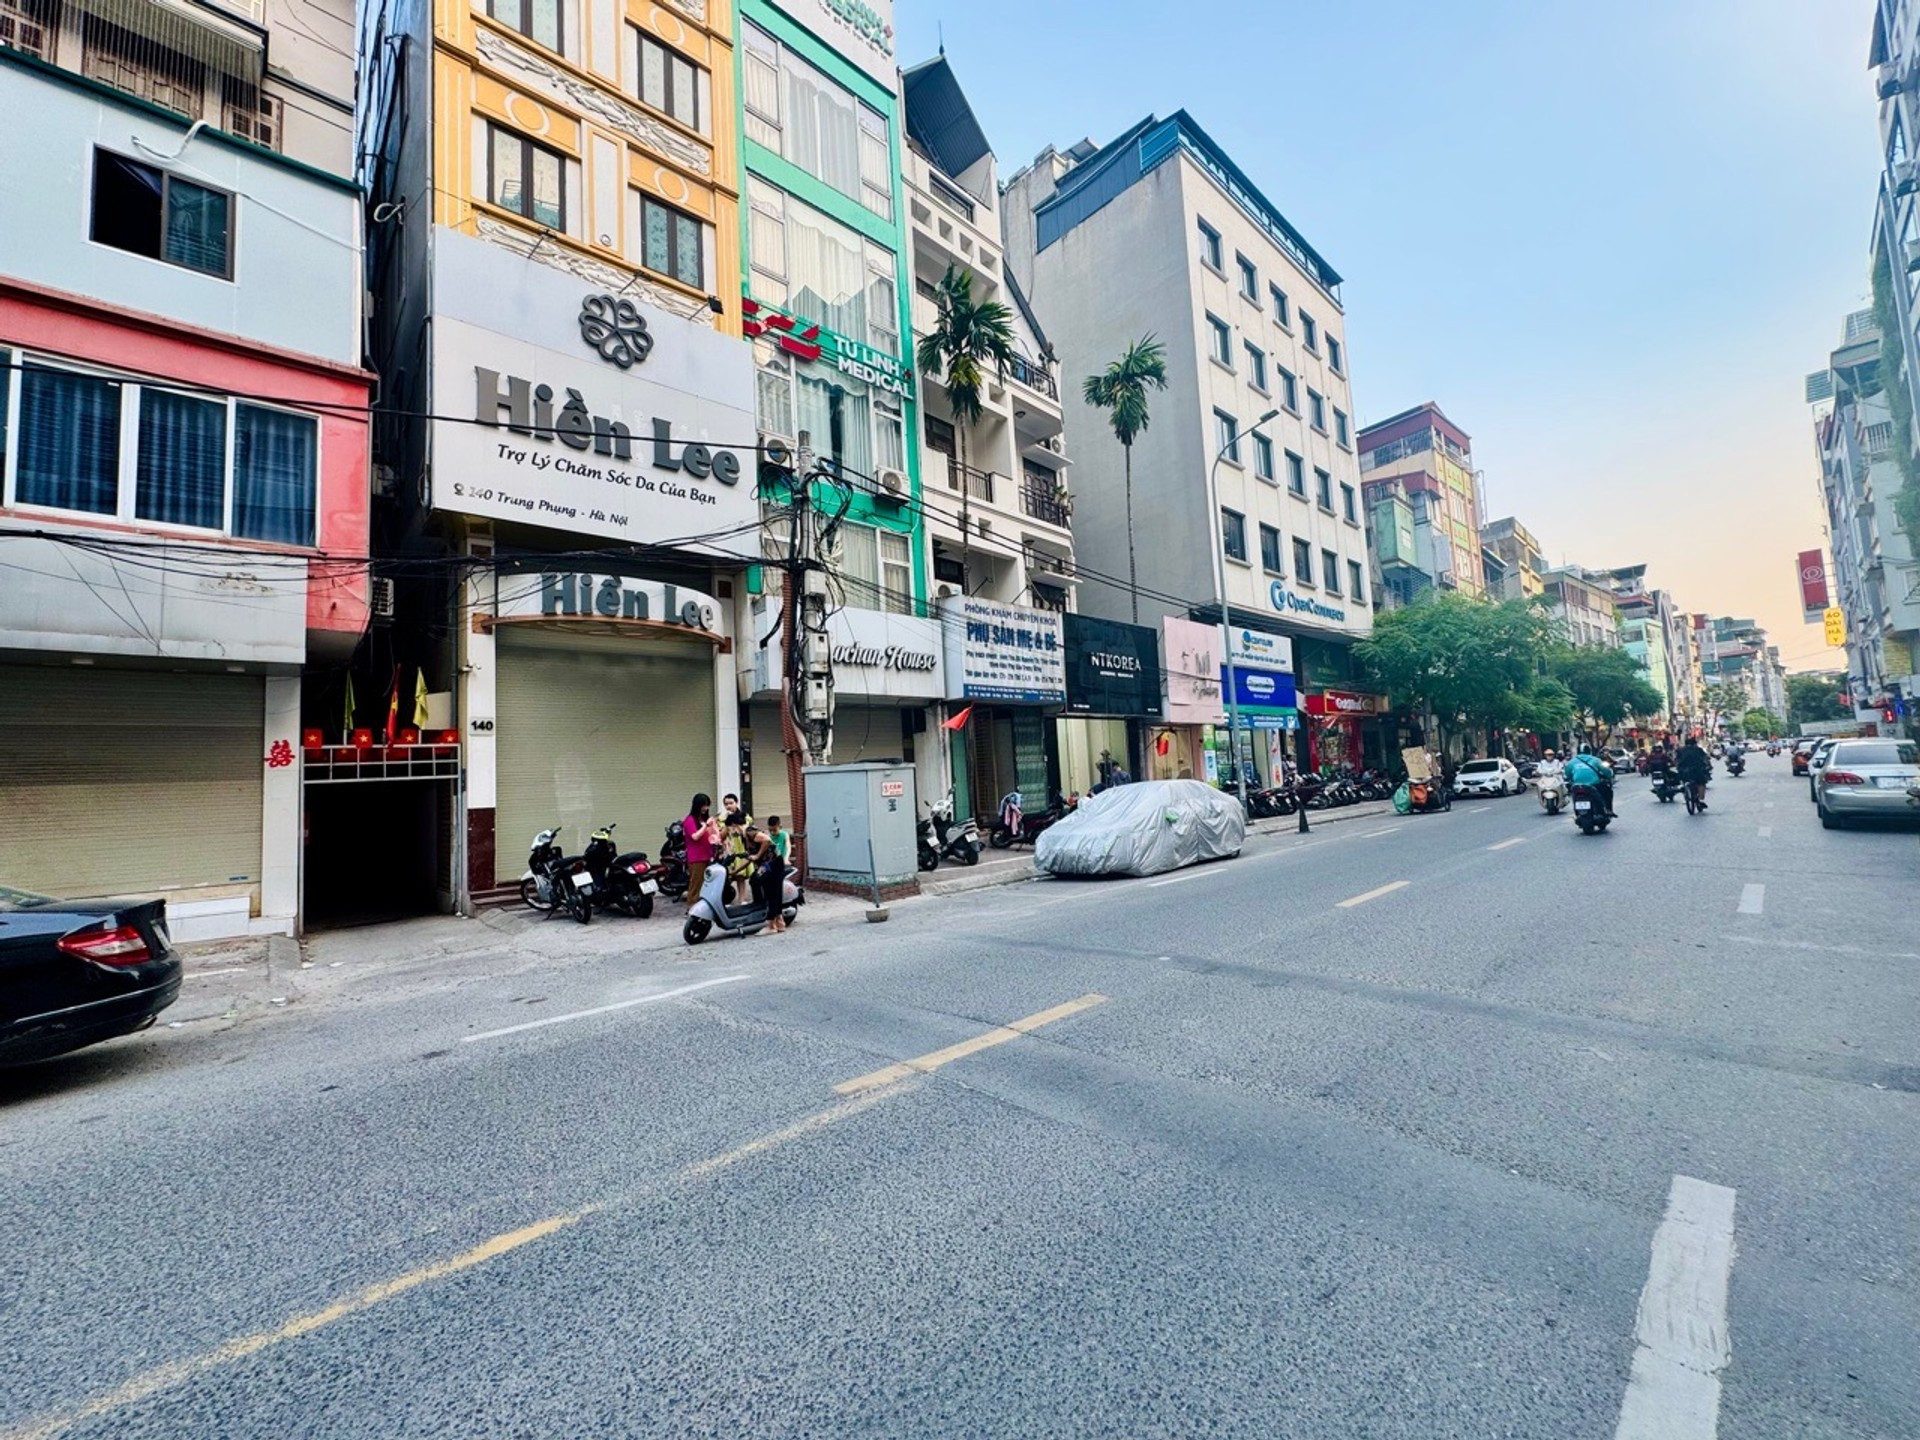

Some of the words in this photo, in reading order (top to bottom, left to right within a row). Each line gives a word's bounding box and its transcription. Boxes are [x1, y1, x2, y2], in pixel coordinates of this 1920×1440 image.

[838, 355, 914, 399] MEDICAL
[862, 347, 900, 377] LINH
[474, 365, 631, 461] Hiền
[652, 417, 741, 487] Lee
[498, 444, 527, 465] Trợ
[531, 451, 551, 470] Lý
[555, 458, 602, 480] Chăm
[606, 469, 632, 486] Sóc
[635, 476, 655, 492] Da
[659, 480, 686, 499] Của
[690, 487, 716, 506] Bạn
[498, 491, 535, 511] Trung
[538, 499, 577, 518] Phụng
[590, 509, 605, 522] Hà
[610, 513, 629, 527] Nội
[541, 574, 649, 620] Hiền
[664, 584, 713, 631] Lee
[965, 603, 991, 616] PHÒNG
[992, 608, 1012, 619] KHÁM
[966, 621, 990, 648] PHỤ
[993, 620, 1016, 647] SẢN
[1017, 628, 1033, 652] MẸ
[1035, 631, 1043, 650] &
[884, 646, 937, 672] House
[1091, 651, 1142, 672] NTKOREA
[471, 720, 493, 731] 140
